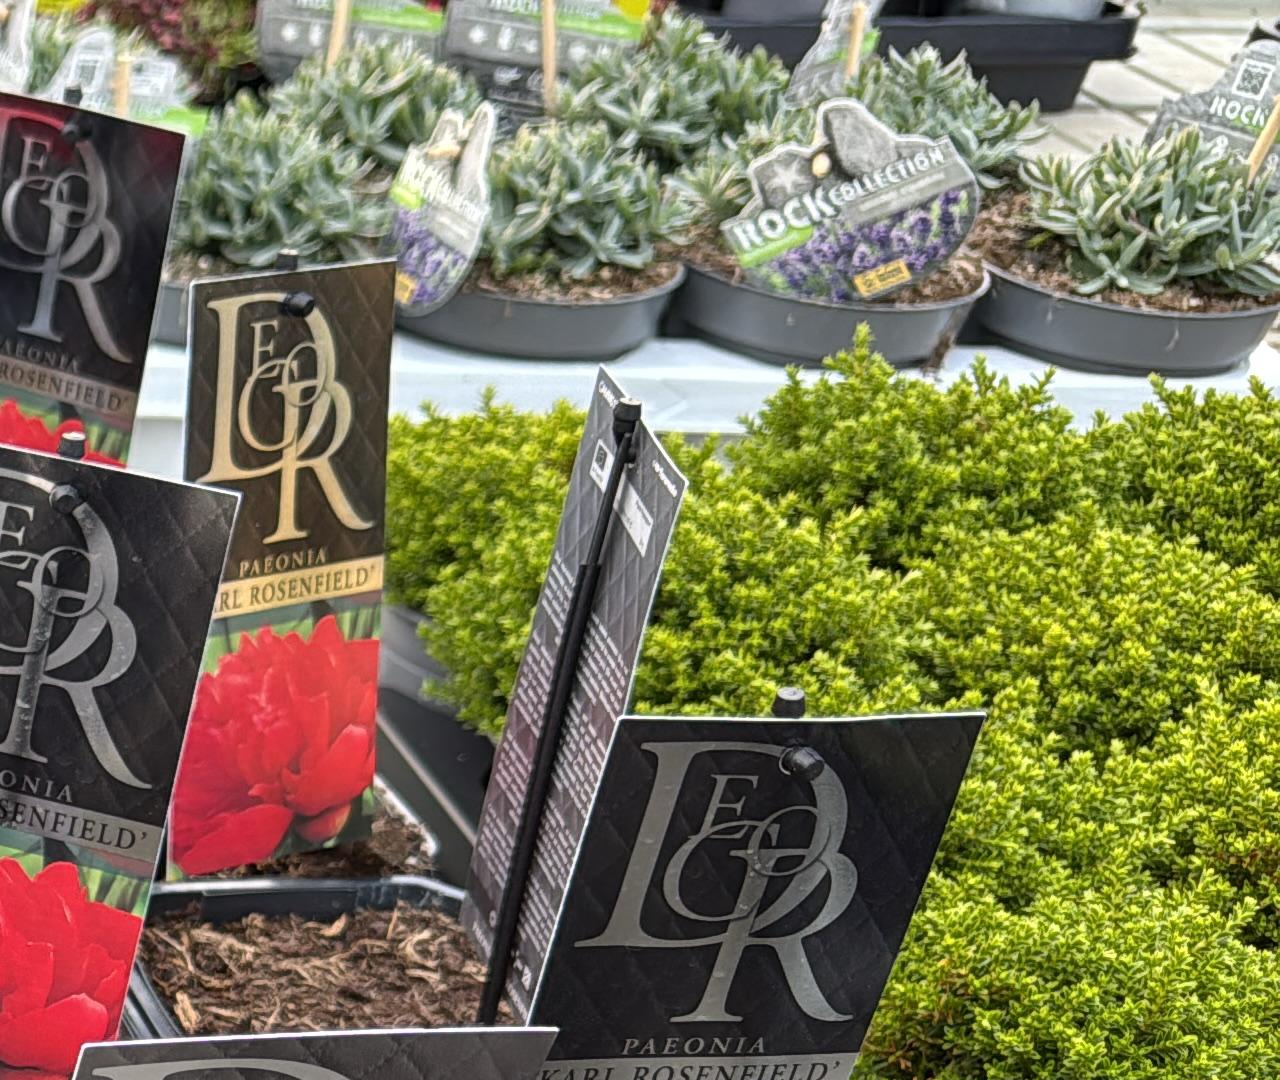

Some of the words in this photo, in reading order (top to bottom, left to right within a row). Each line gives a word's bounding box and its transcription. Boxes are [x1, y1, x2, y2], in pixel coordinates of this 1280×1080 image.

[733, 186, 838, 250] ROCK
[827, 146, 947, 201] COLLECTION
[239, 546, 328, 578] PAEONIA
[216, 589, 243, 613] RL
[251, 563, 376, 605] ROSENFIELD'
[622, 1036, 766, 1056] PAEONIA
